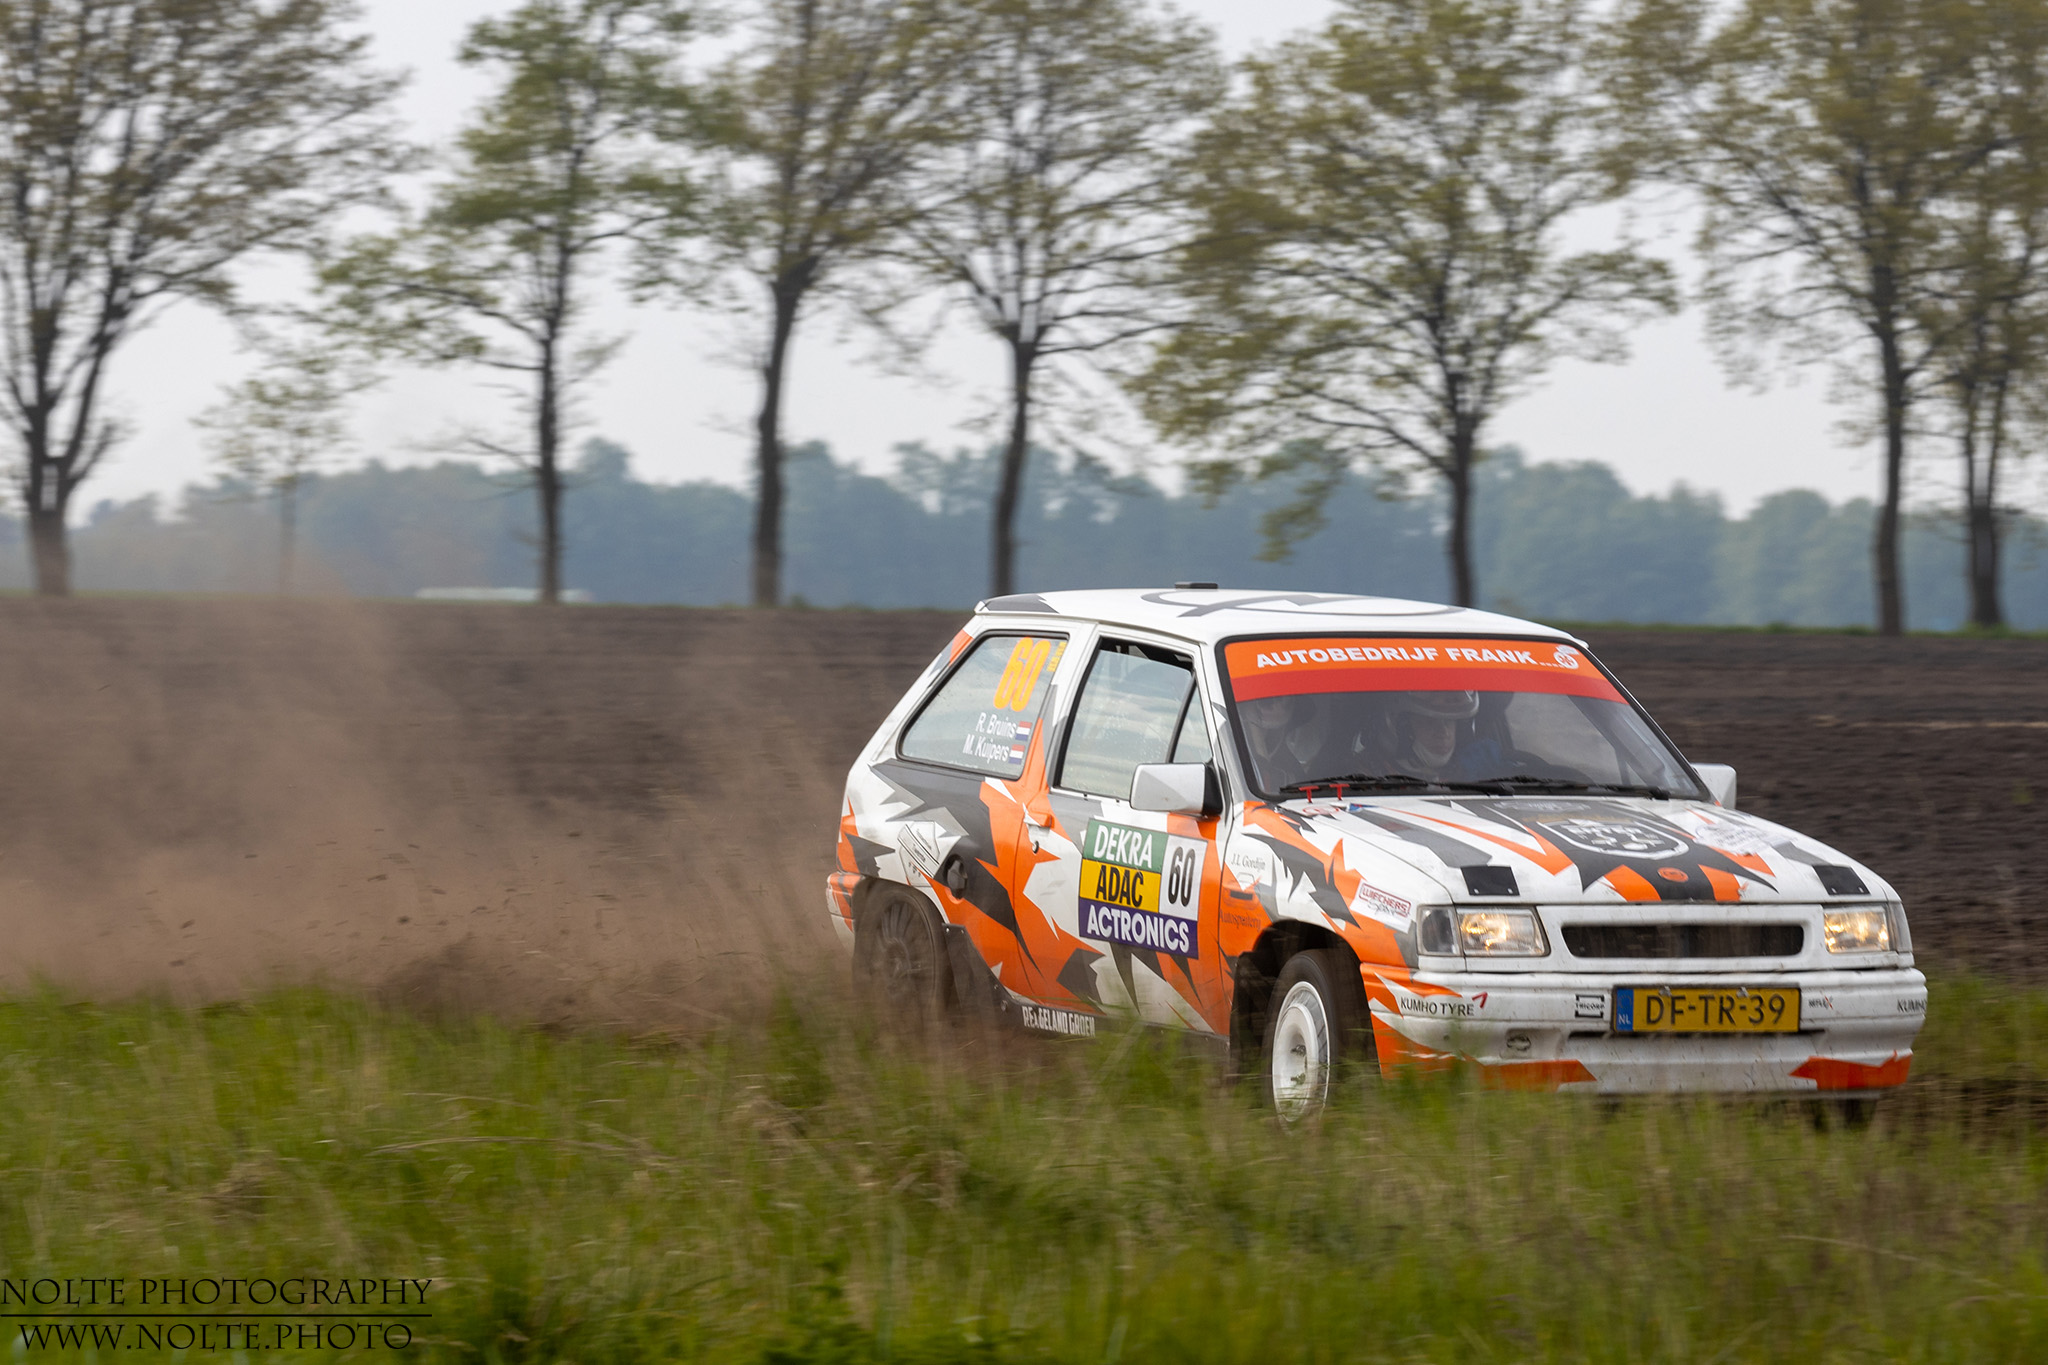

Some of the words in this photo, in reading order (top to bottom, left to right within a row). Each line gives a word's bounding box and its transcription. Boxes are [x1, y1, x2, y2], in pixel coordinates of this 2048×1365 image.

[1257, 647, 1439, 668] AUTOBEDRIJF
[993, 637, 1051, 712] 60
[975, 712, 988, 733] R.
[987, 714, 1017, 738] Bruins
[963, 734, 975, 755] M.
[975, 737, 1009, 763] Kuipers
[1093, 824, 1153, 868] DEKRA
[1095, 865, 1144, 907] ADAC
[1168, 847, 1196, 907] 60
[1087, 904, 1190, 953] ACTRONICS
[1401, 996, 1438, 1014] KUMHO
[1440, 1002, 1475, 1016] TYRE
[1618, 1013, 1632, 1025] NL
[1646, 994, 1786, 1025] DF-TR-39
